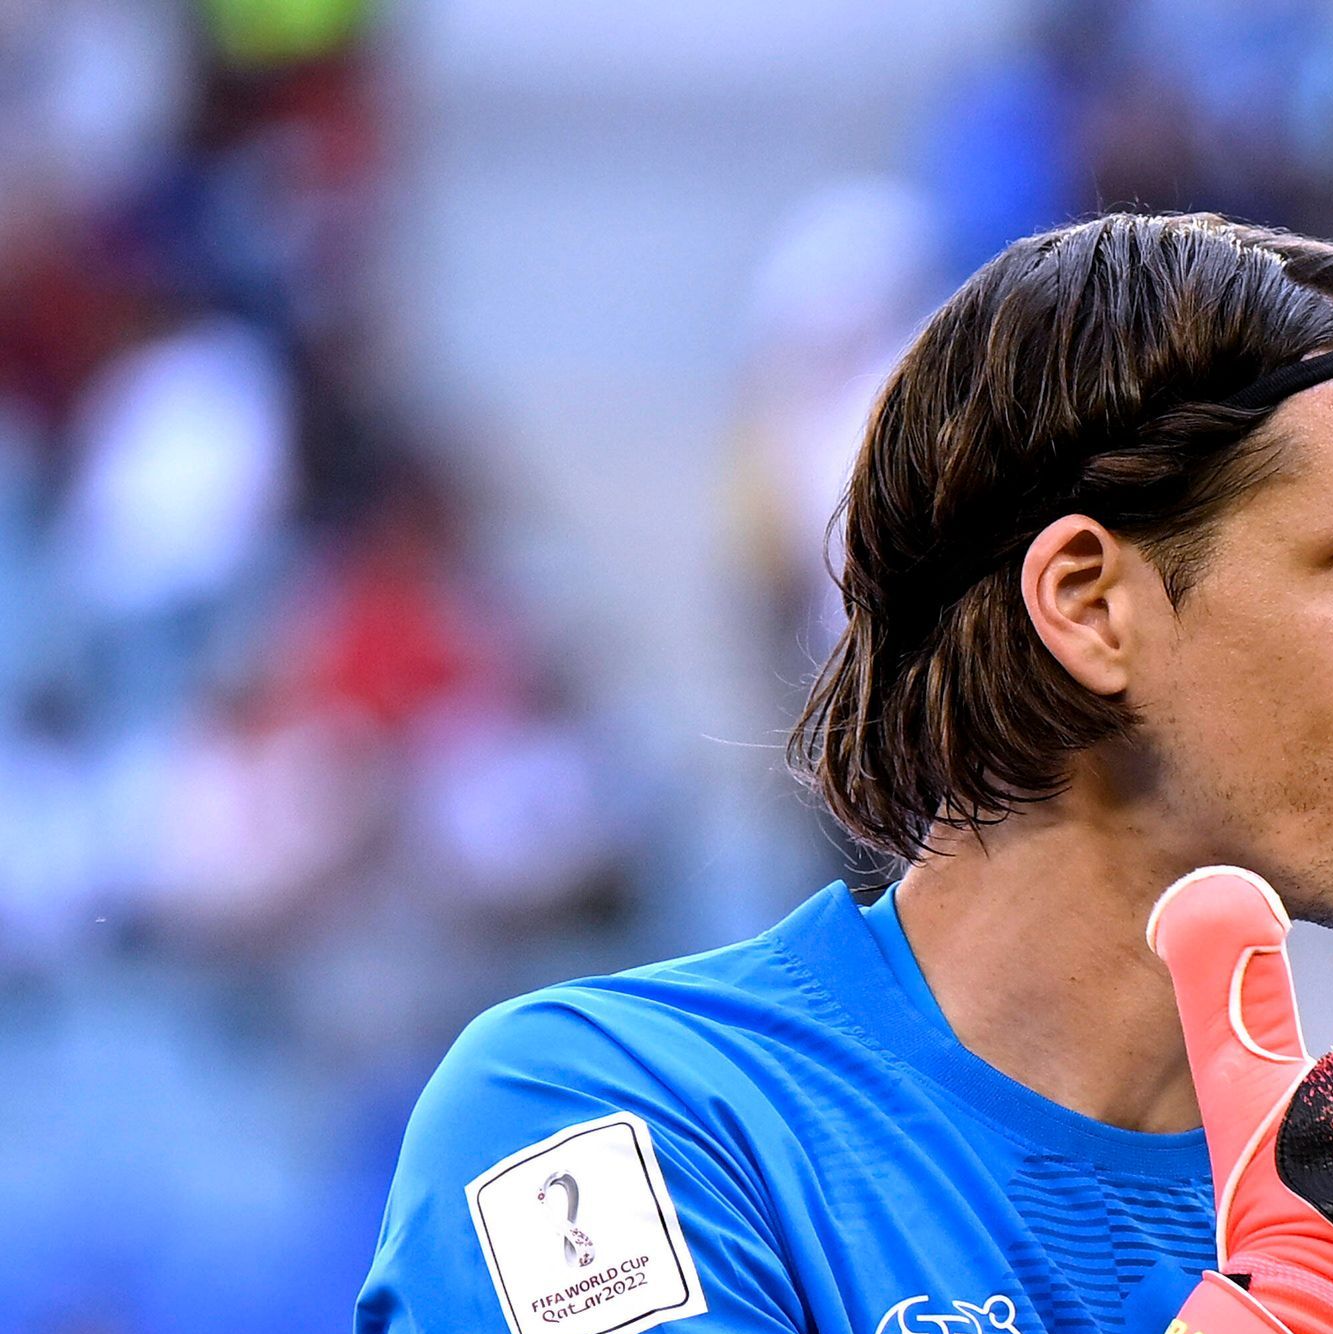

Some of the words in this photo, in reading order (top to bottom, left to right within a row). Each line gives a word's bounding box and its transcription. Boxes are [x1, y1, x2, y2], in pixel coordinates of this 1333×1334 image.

[531, 1292, 566, 1313] FIFA
[564, 1267, 618, 1299] WORLD
[620, 1255, 650, 1273] CUP
